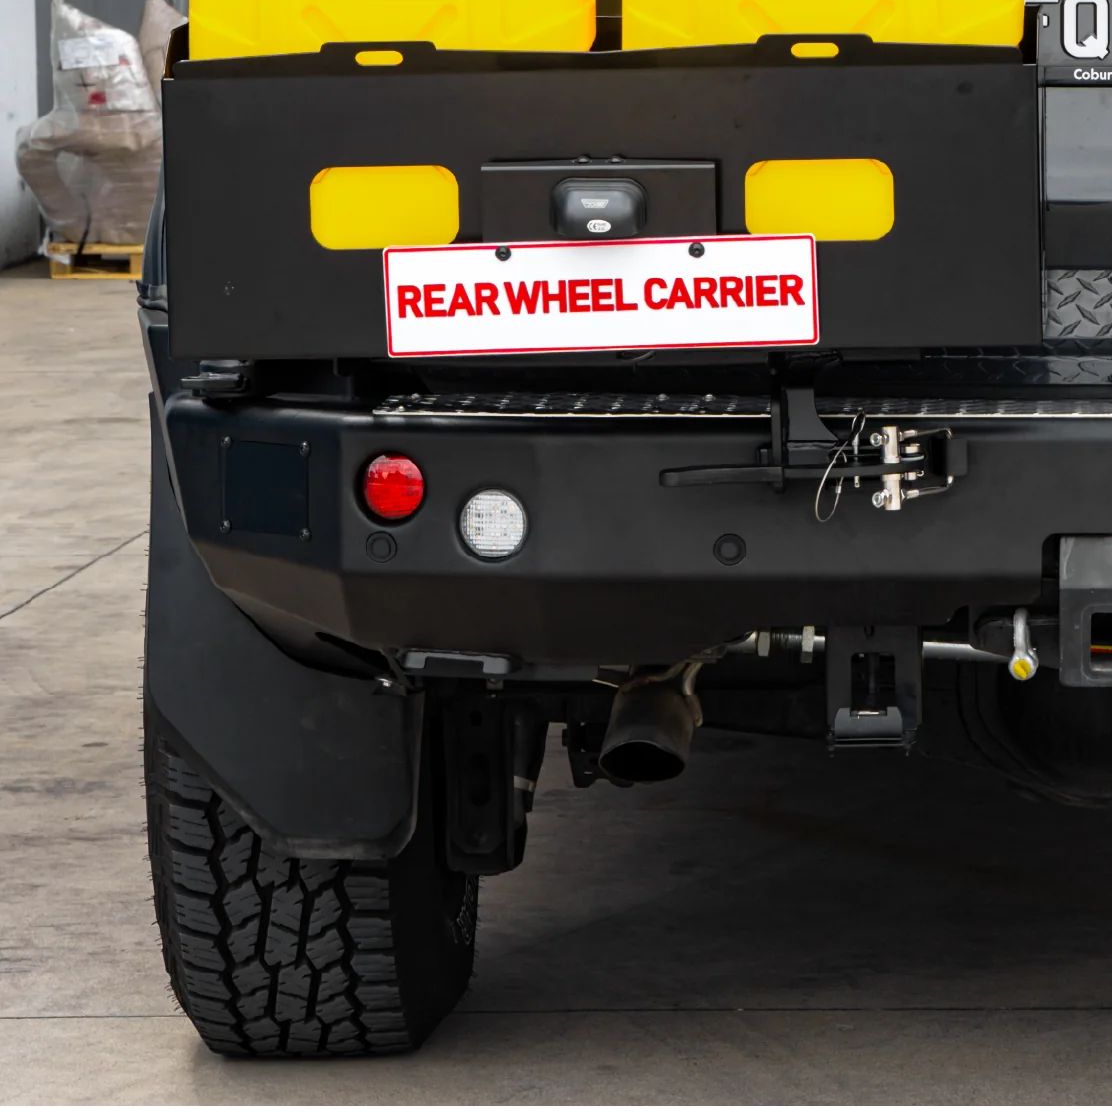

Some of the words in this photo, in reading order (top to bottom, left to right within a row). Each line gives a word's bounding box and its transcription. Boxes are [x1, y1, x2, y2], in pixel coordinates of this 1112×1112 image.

[397, 282, 501, 318] REAR
[504, 278, 639, 315] WHEEL
[643, 273, 806, 310] CARRIER
